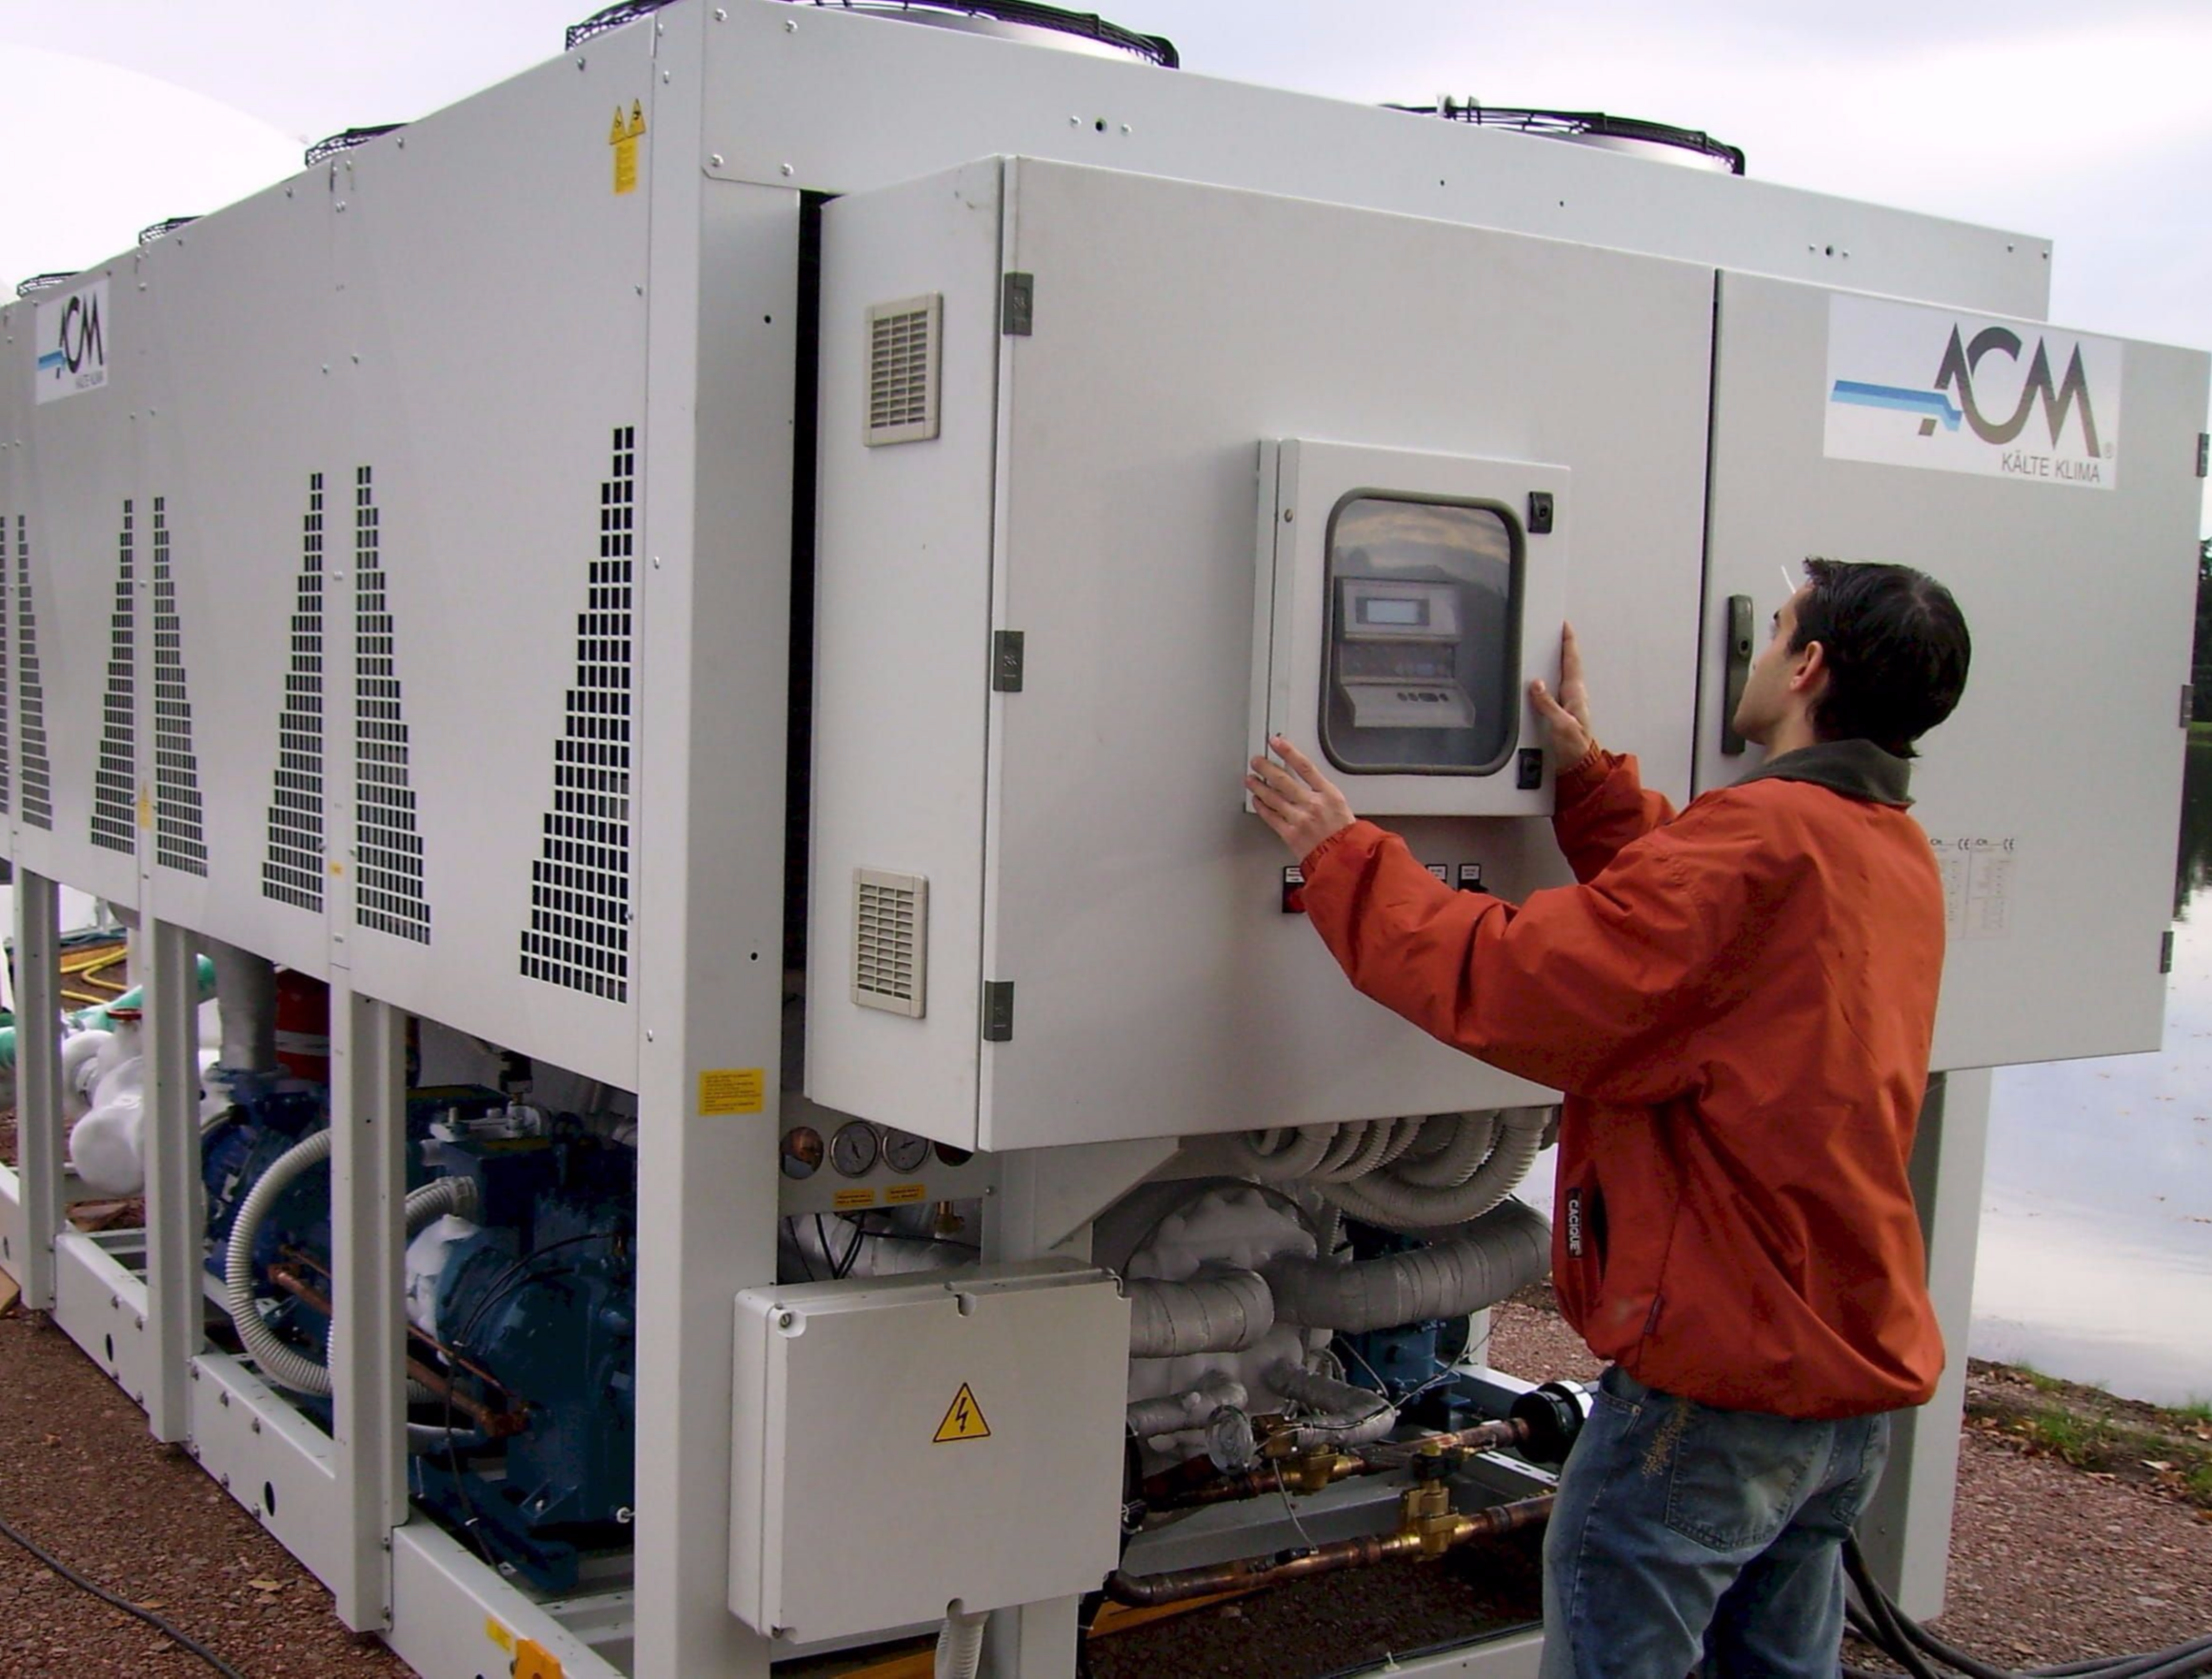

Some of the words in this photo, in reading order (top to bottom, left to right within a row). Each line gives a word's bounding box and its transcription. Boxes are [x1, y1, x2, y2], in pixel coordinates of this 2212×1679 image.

[56, 290, 103, 378] ACM
[1919, 322, 2101, 458] ACM
[2002, 450, 2049, 477] KÄLTE
[2055, 459, 2101, 483] KLIMA
[1568, 1199, 1581, 1250] CACIQUE
